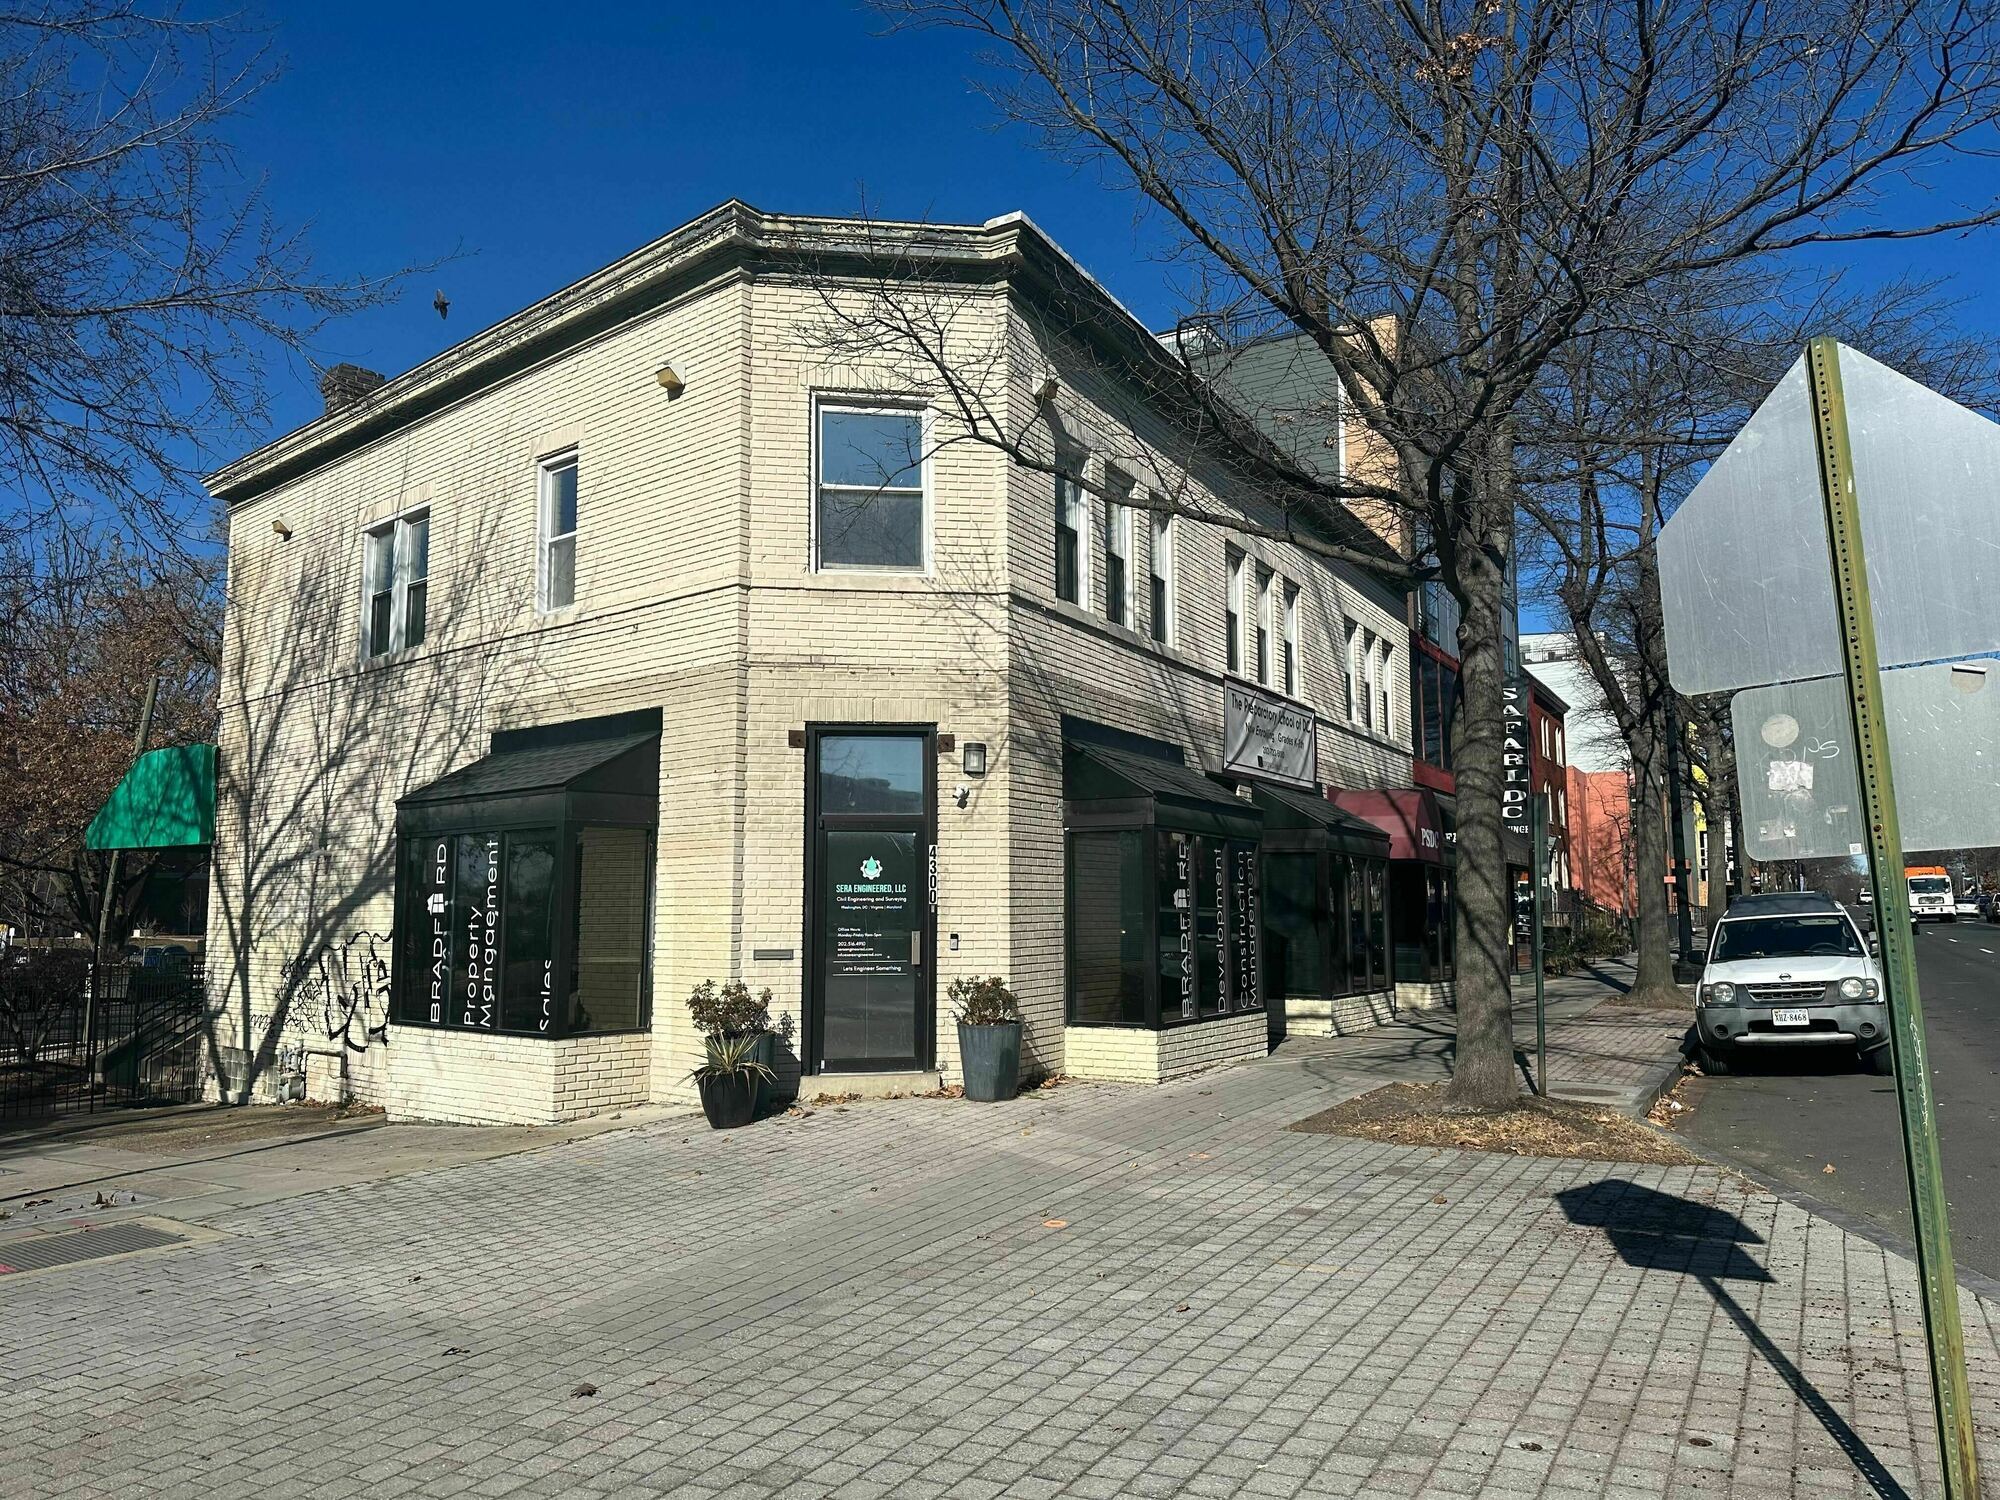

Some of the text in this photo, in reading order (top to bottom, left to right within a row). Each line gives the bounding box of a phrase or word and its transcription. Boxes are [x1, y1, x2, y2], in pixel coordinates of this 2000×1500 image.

[1231, 693, 1242, 710] The
[1296, 718, 1302, 730] of
[1302, 718, 1311, 733] DC
[1502, 687, 1526, 818] SAFARI DC
[836, 884, 907, 894] SERA ENGINEERED, LLC
[929, 845, 937, 904] 4300
[1420, 828, 1440, 848] PSDC
[464, 906, 483, 1025] Property
[1214, 848, 1226, 1013] Development
[1237, 852, 1248, 1009] Construction
[1246, 851, 1257, 1007] Management
